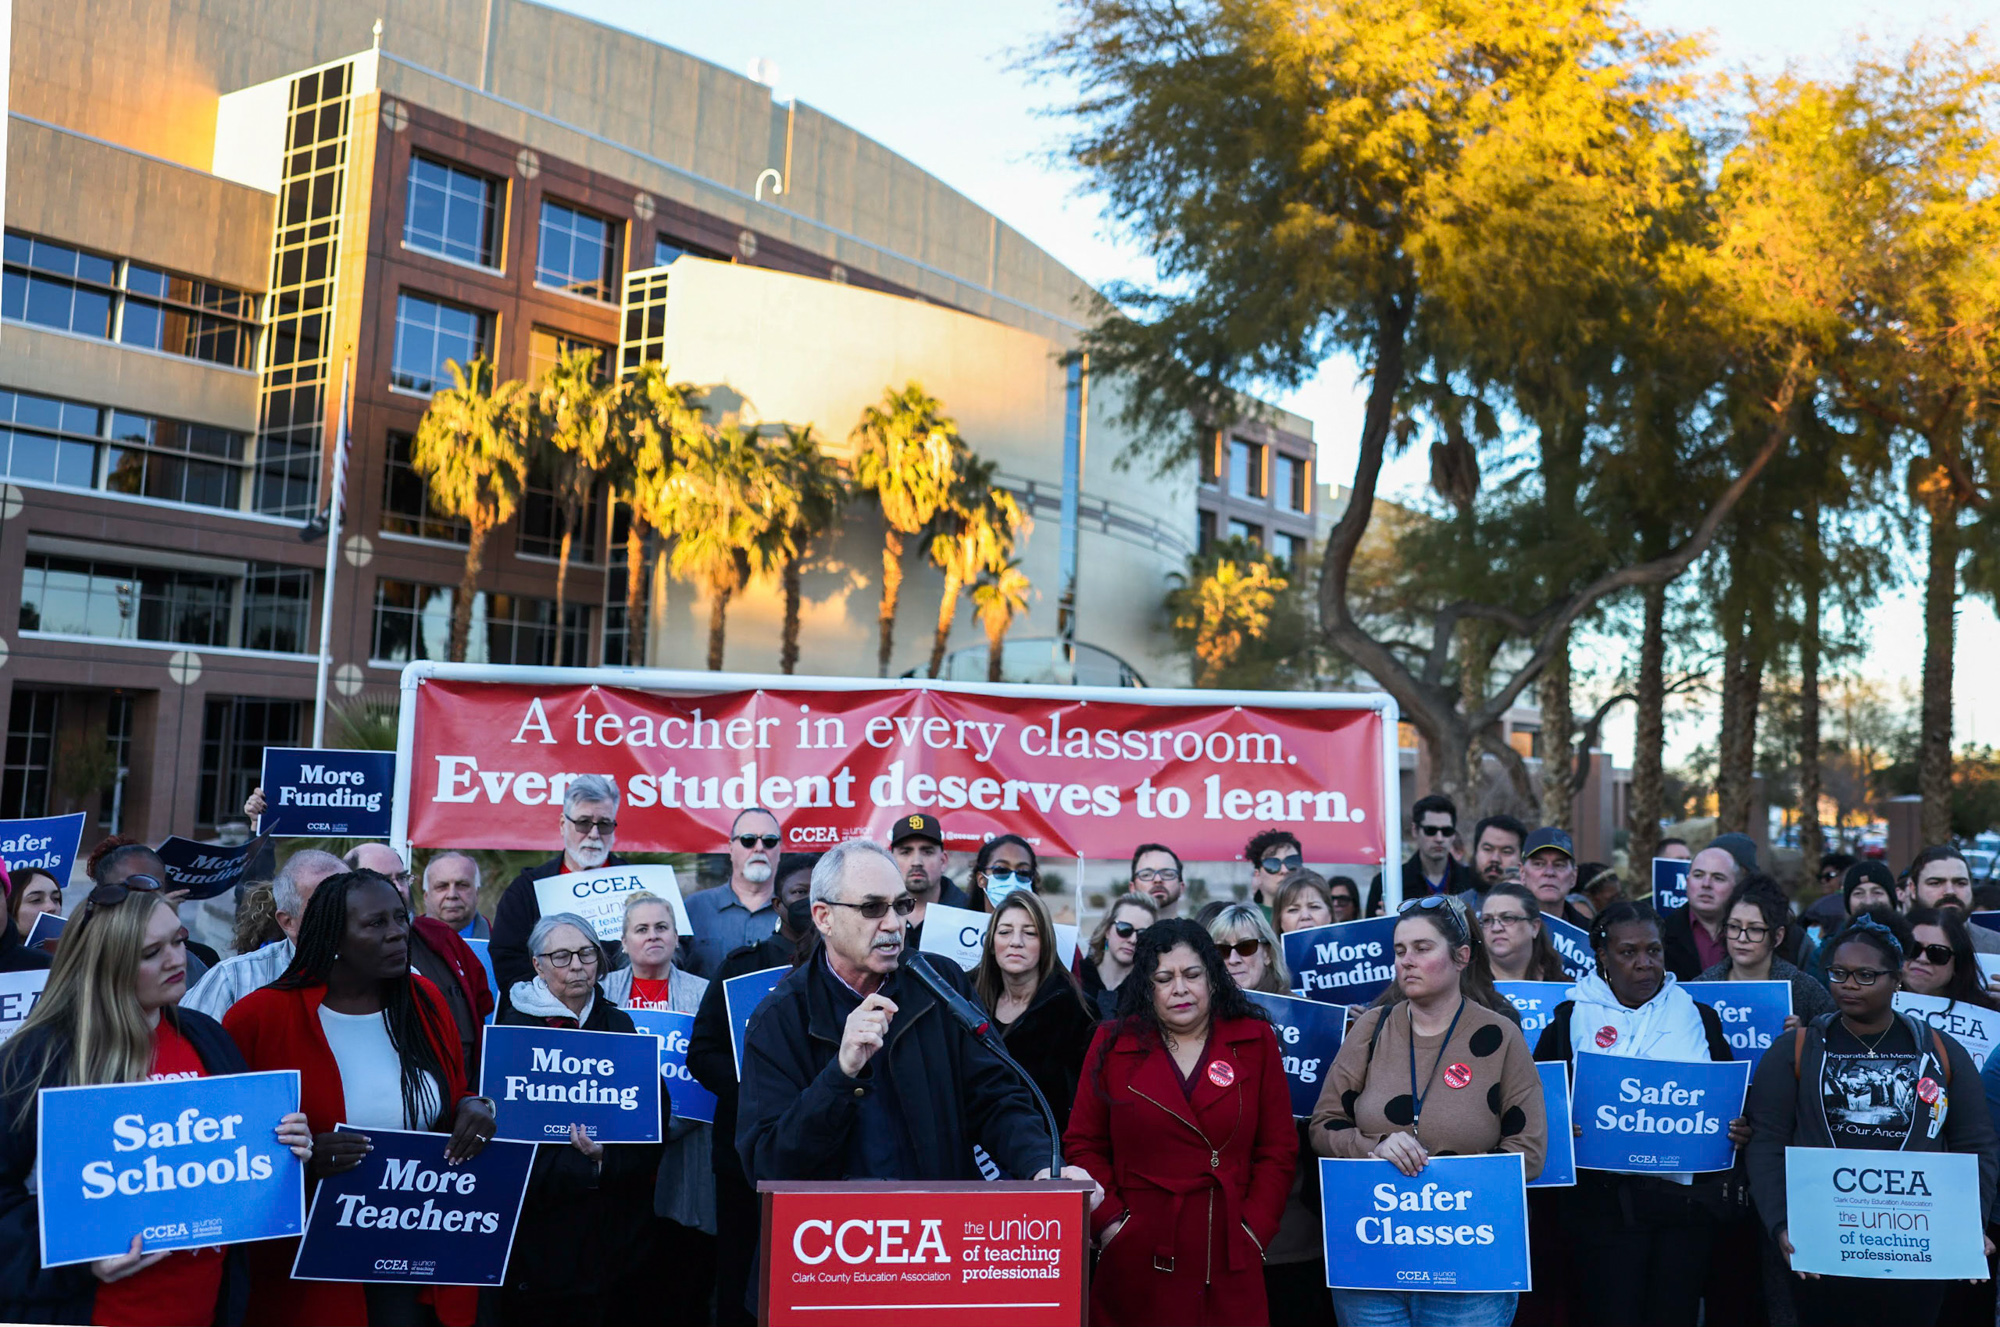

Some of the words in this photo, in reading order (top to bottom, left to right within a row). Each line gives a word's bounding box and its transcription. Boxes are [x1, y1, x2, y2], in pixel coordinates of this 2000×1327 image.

[511, 697, 558, 744] A
[573, 704, 780, 750] teacher
[796, 704, 847, 749] in
[865, 716, 1005, 762] every
[1020, 711, 1297, 765] classroom.
[299, 764, 365, 785] More
[278, 786, 382, 812] Funding
[432, 755, 614, 806] Ever
[627, 761, 856, 810] student
[870, 760, 1121, 817] deserves
[1135, 778, 1191, 819] to
[1203, 774, 1366, 823] learn.
[0, 834, 52, 853] afer
[789, 826, 840, 842] CCEA
[0, 851, 61, 872] hools
[572, 875, 646, 898] CCEA
[1314, 941, 1383, 966] More
[1553, 932, 1597, 970] Mor
[1713, 1000, 1752, 1023] fer
[530, 1047, 615, 1076] More
[504, 1075, 639, 1111] Funding
[1619, 1077, 1705, 1106] Safer
[113, 1108, 243, 1152] Safer
[1595, 1105, 1719, 1134] Schools
[1831, 1123, 1846, 1132] Of
[1846, 1124, 1871, 1135] Our
[1872, 1128, 1908, 1138] Ances
[1628, 1154, 1658, 1164] CCEA
[82, 1145, 273, 1199] Schools
[378, 1158, 477, 1195] More
[1832, 1167, 1932, 1196] CCEA
[1373, 1183, 1473, 1212] Safer
[1849, 1197, 1870, 1205] County
[1900, 1199, 1933, 1208] Association
[336, 1193, 499, 1234] Teachers
[1839, 1211, 1857, 1222] the
[1861, 1207, 1929, 1231] union
[143, 1222, 189, 1240] CCEA
[964, 1221, 985, 1235] the
[989, 1213, 1061, 1241] union
[1355, 1216, 1495, 1245] Classes
[793, 1219, 951, 1265] CCEA
[1840, 1231, 1855, 1244] of
[1859, 1233, 1930, 1252] teaching
[374, 1259, 409, 1270] CCEA
[962, 1245, 981, 1262] of
[984, 1244, 1061, 1265] teaching
[1840, 1248, 1933, 1263] professionals
[792, 1271, 816, 1283] Clark
[818, 1271, 851, 1284] County
[853, 1271, 898, 1282] Education
[900, 1271, 951, 1282] Association
[962, 1265, 1060, 1283] professionals
[1396, 1271, 1431, 1280] CCEA
